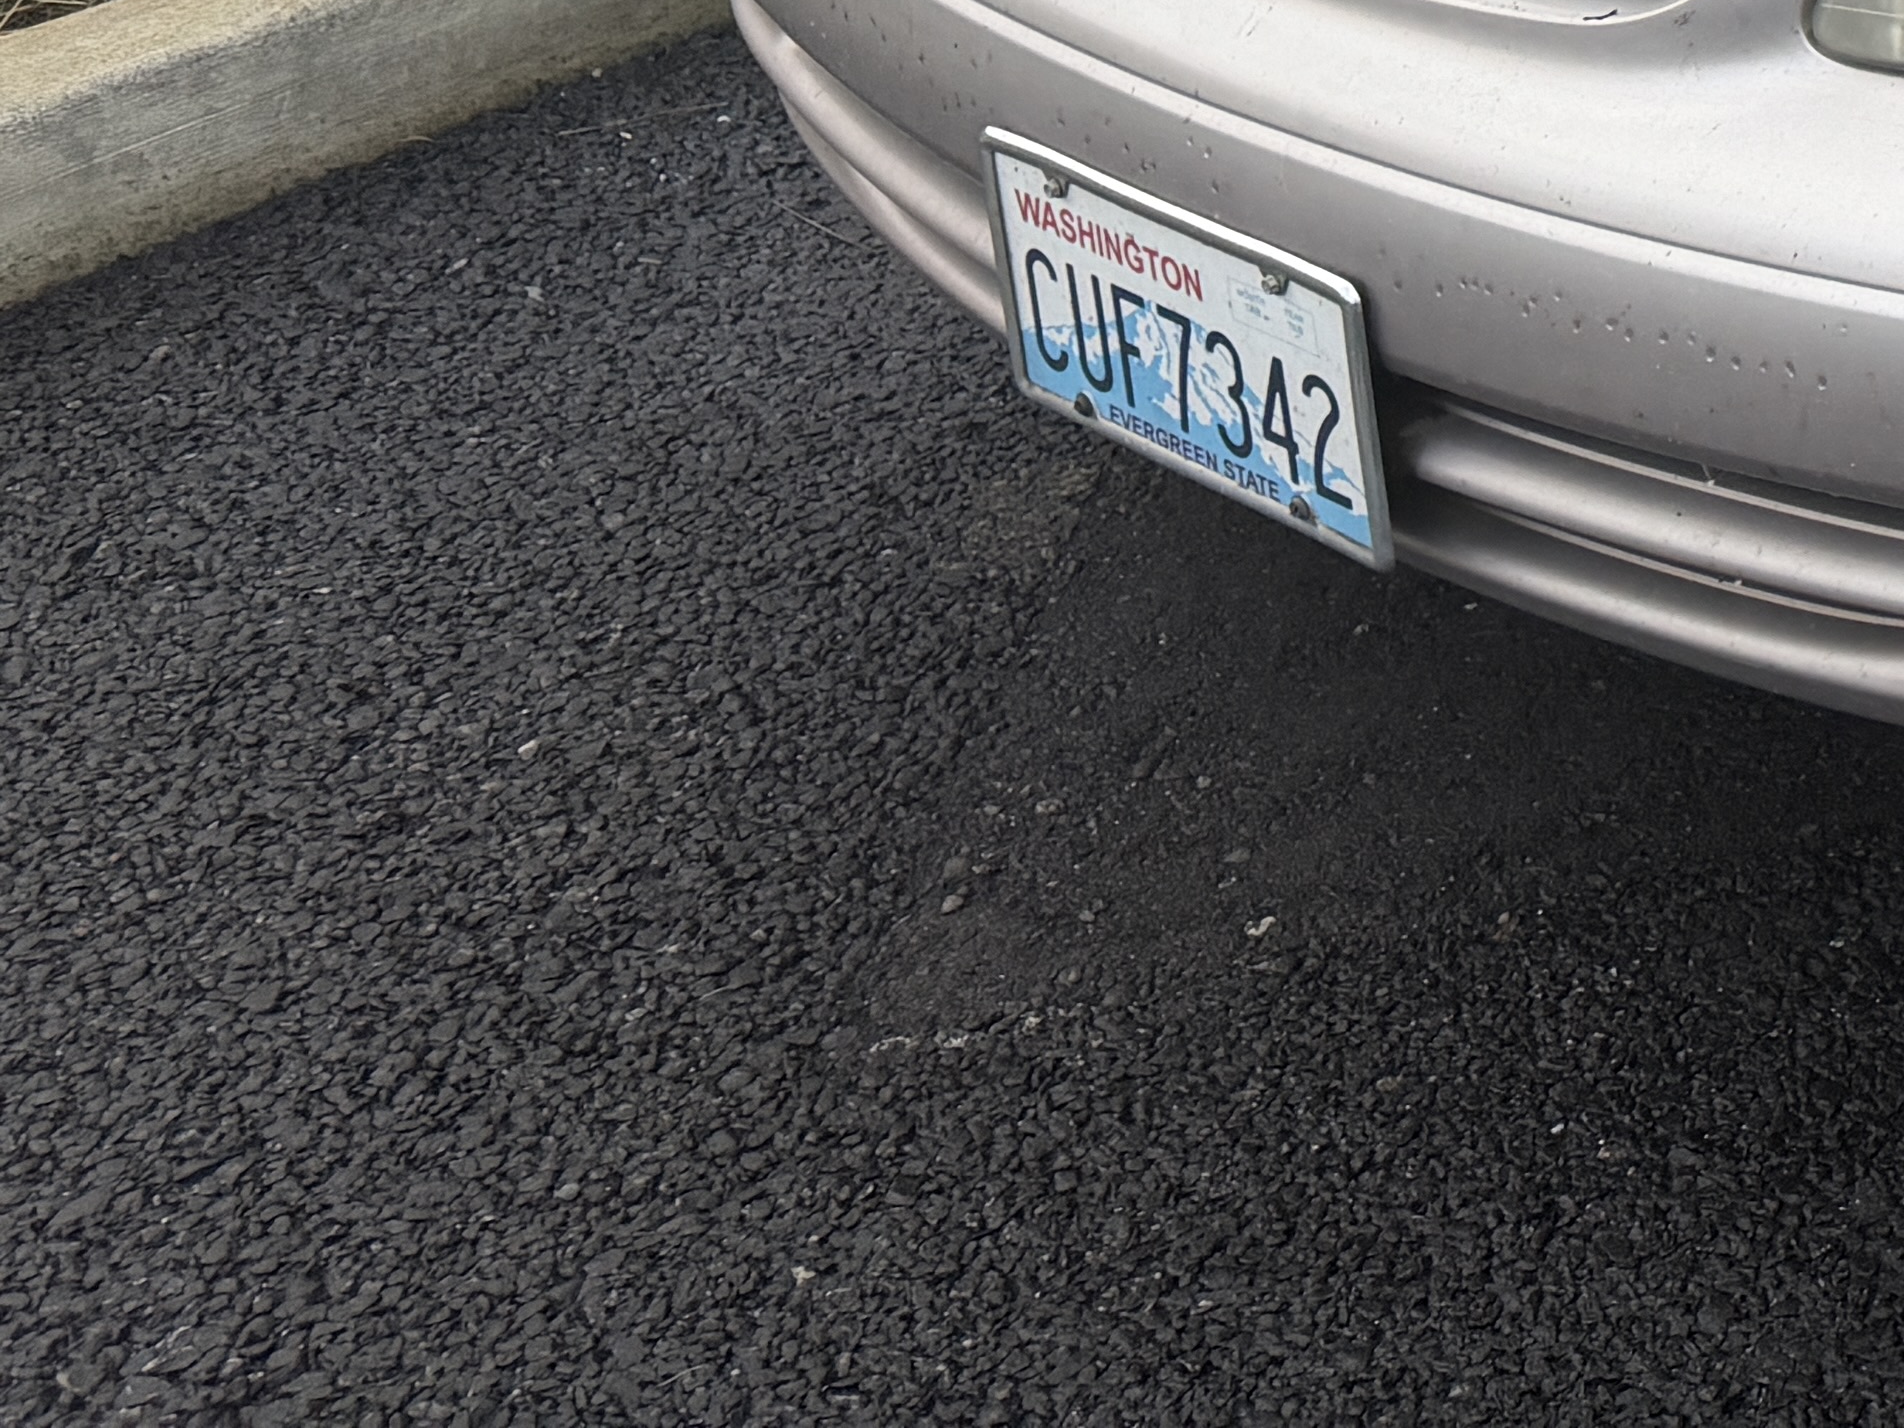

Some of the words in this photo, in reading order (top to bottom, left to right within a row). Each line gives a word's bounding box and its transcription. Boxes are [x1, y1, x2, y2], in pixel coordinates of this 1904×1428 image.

[1014, 188, 1204, 301] WASHINGTON
[1026, 248, 1353, 510] CUF7342
[1110, 402, 1219, 469] EVERGREEN
[1223, 457, 1281, 502] STATE
